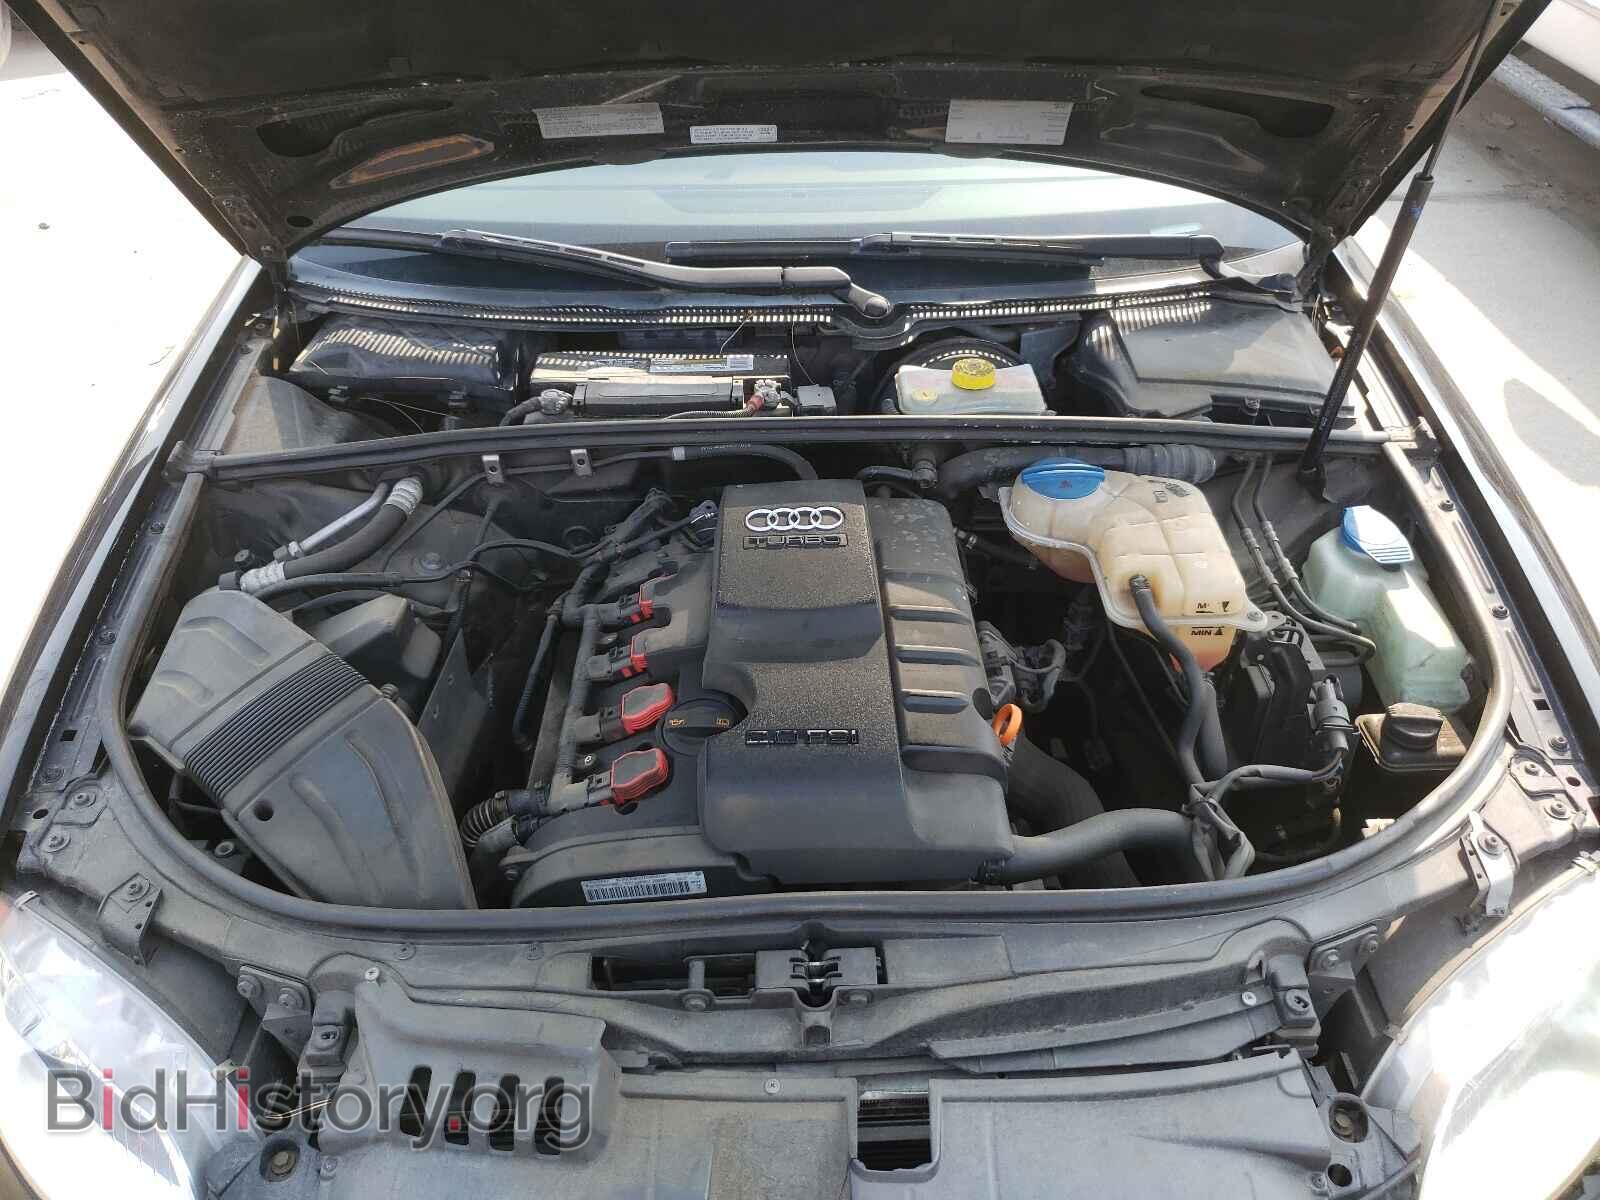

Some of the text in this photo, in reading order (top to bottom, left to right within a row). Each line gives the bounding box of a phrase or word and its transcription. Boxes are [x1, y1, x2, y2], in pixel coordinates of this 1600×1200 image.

[744, 534, 848, 549] TURBO
[746, 729, 859, 745] 2.0 FSI
